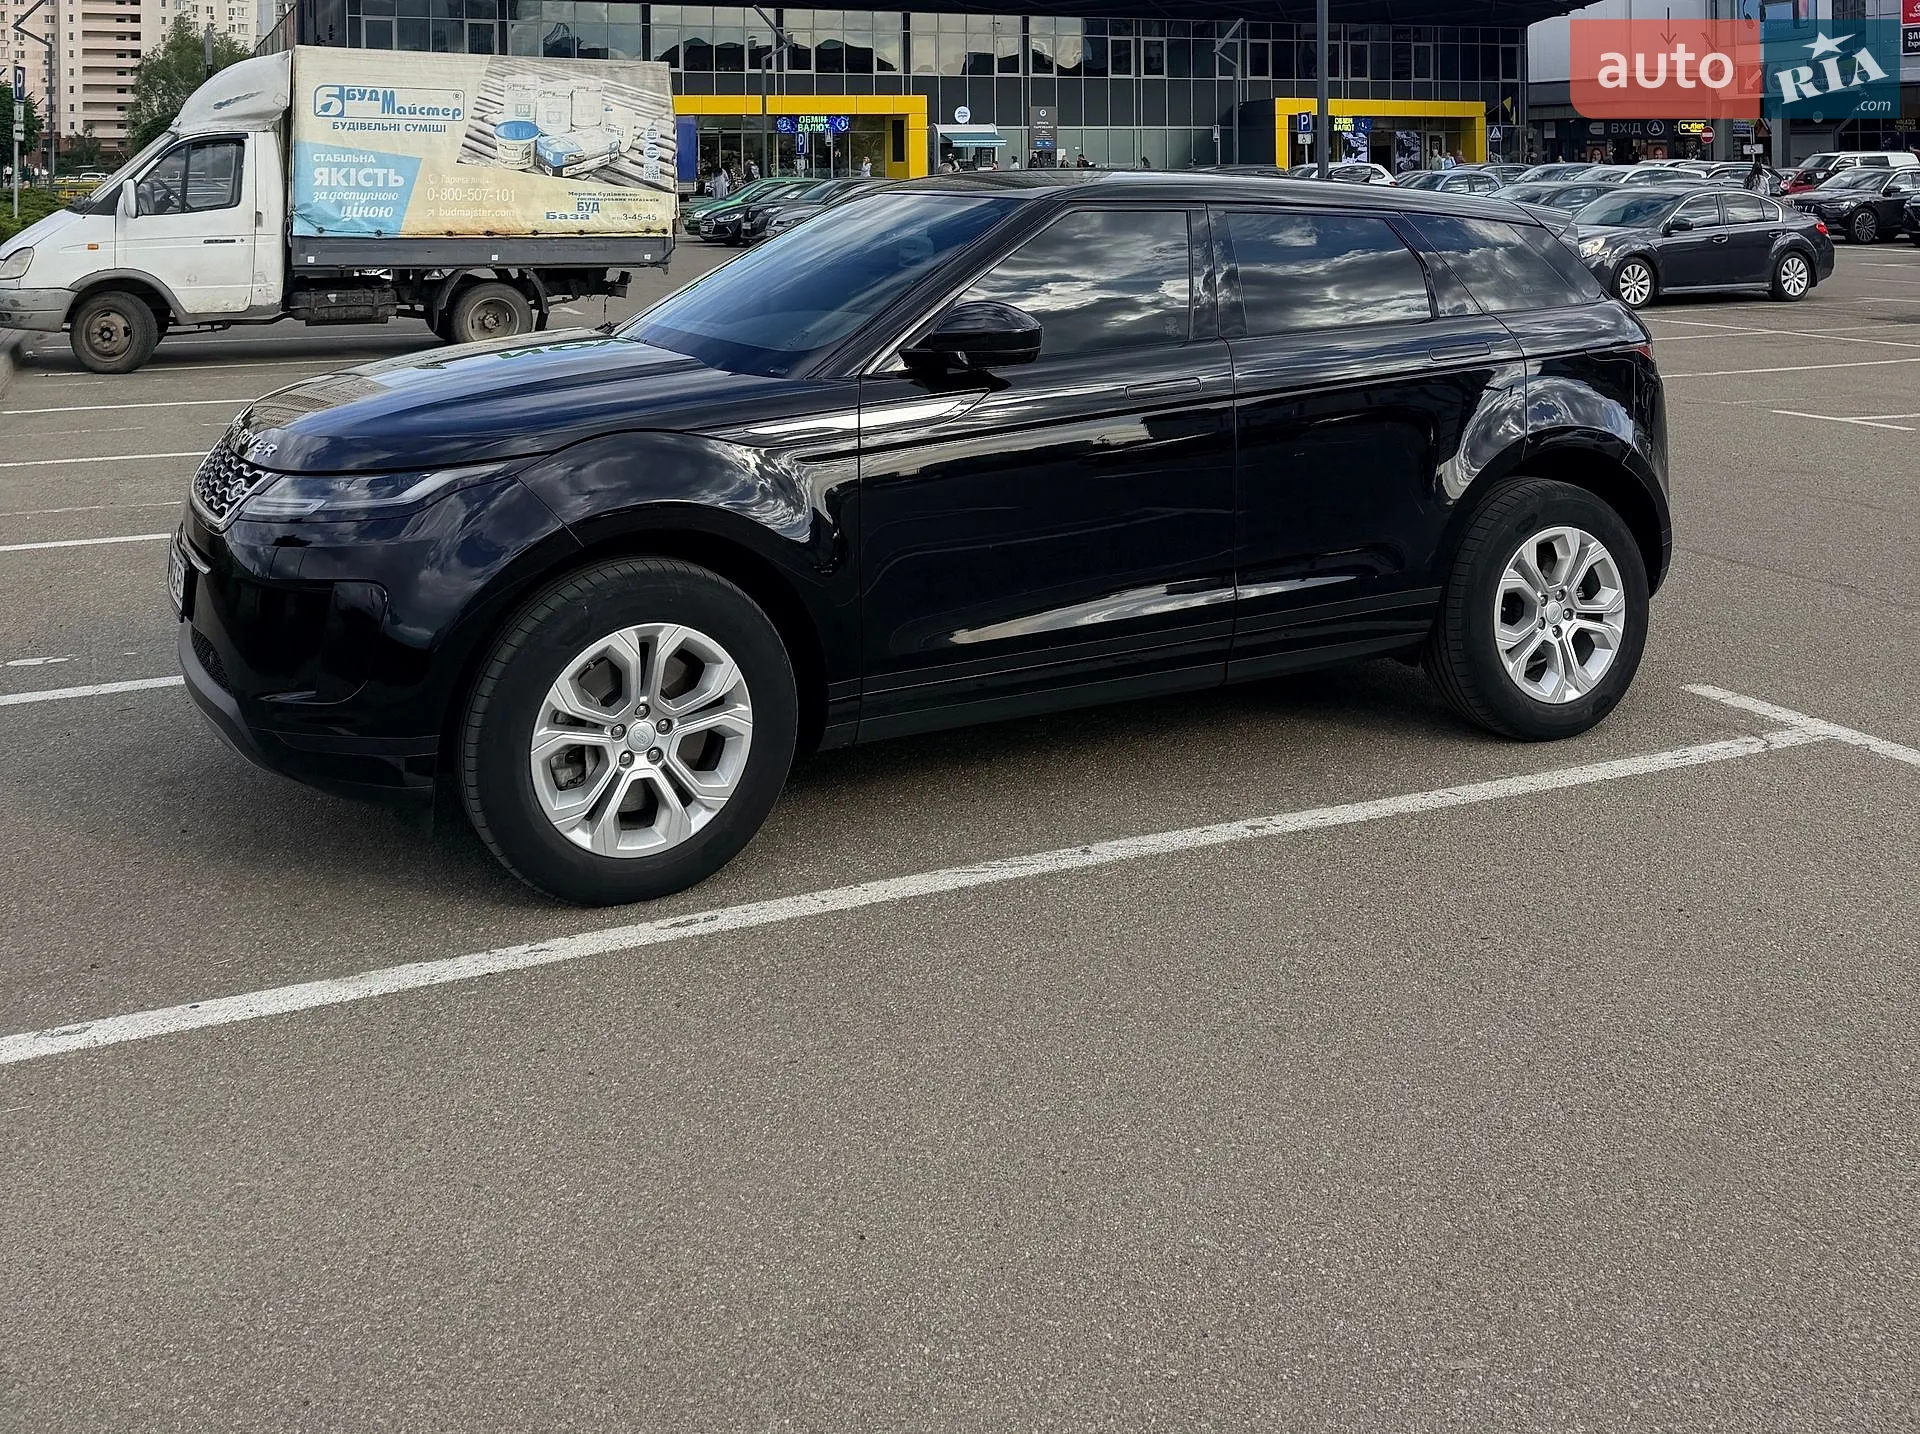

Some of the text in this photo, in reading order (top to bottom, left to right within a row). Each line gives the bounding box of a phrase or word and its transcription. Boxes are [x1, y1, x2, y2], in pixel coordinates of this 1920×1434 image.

[16, 69, 23, 97] P
[345, 88, 380, 102] БУД
[381, 89, 462, 120] Майстер
[798, 115, 828, 124] ОБМІН
[1300, 114, 1309, 131] P
[332, 121, 446, 133] БУДІВЕЛЬНІ СУМІШІ
[1610, 122, 1641, 135] ВХІД
[798, 133, 805, 152] P
[312, 153, 376, 164] СТАБІЛЬНА
[312, 167, 405, 187] ЯКІСТЬ
[328, 191, 399, 203] доступною
[427, 187, 515, 202] 0-800-507-101
[340, 202, 394, 221] ціною
[576, 201, 600, 214] БУД
[545, 211, 591, 221] База
